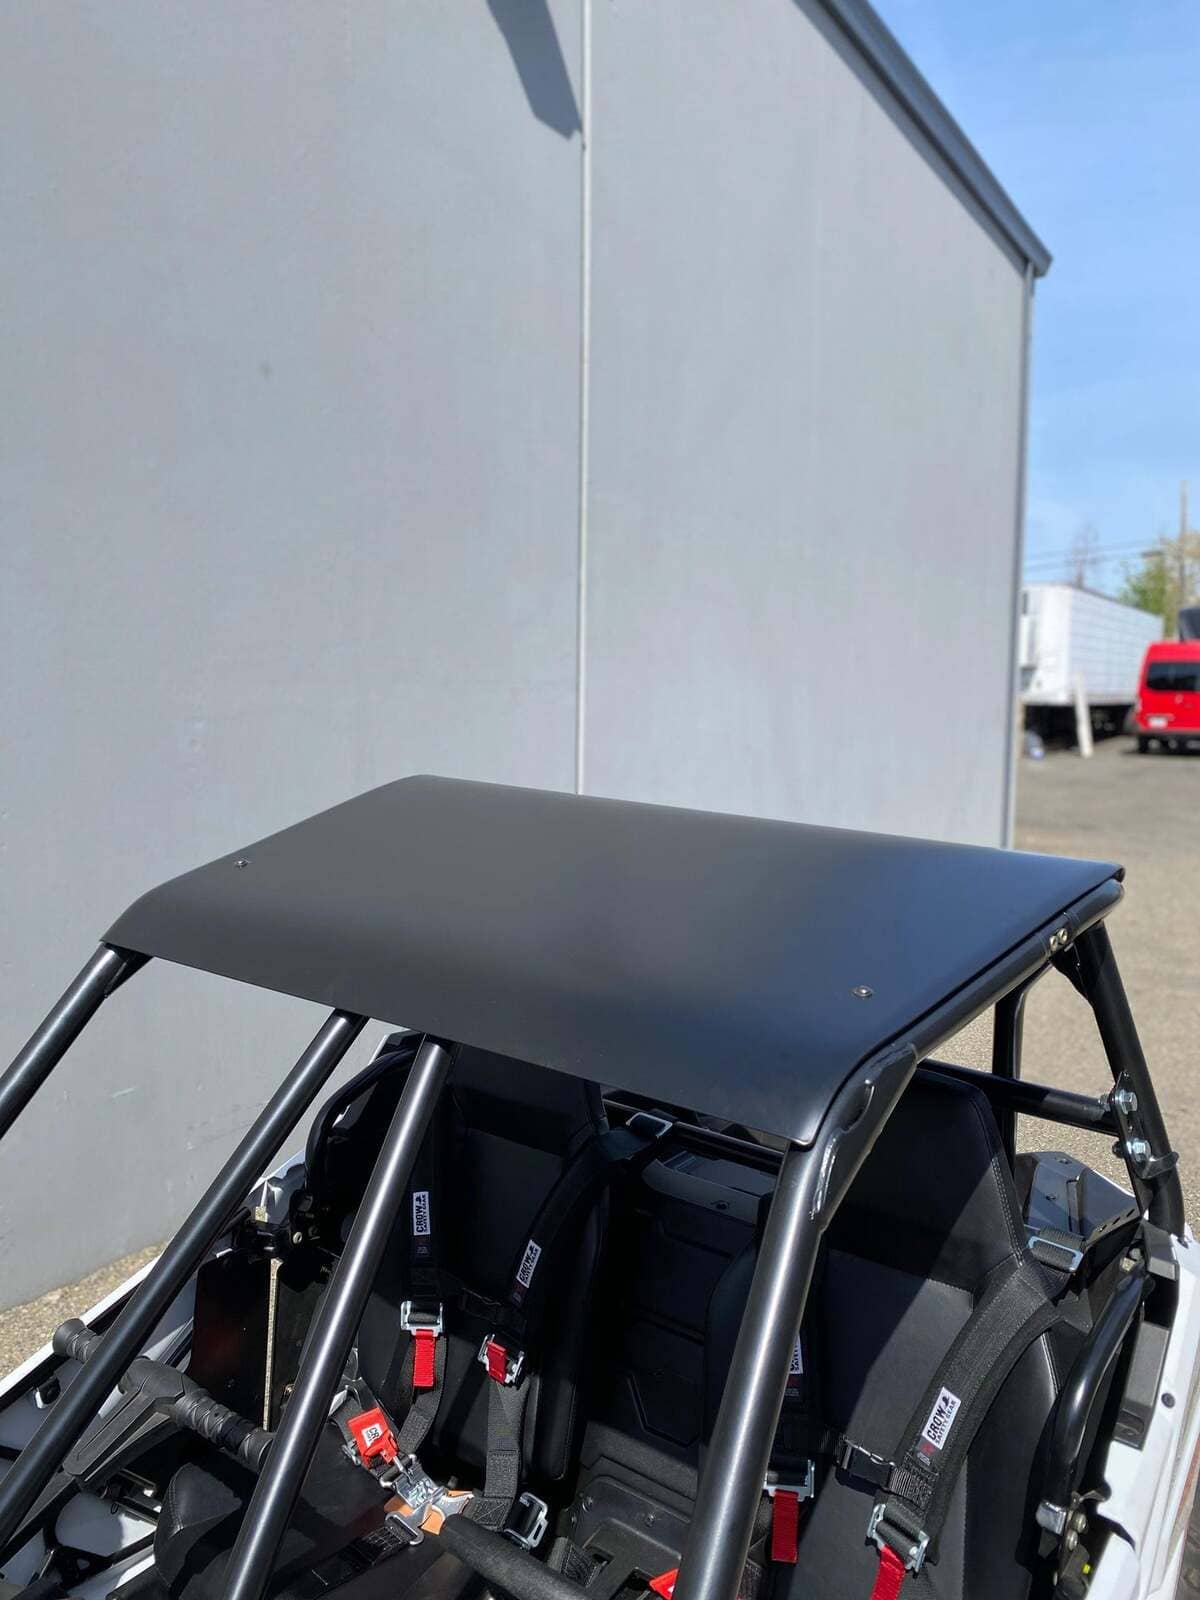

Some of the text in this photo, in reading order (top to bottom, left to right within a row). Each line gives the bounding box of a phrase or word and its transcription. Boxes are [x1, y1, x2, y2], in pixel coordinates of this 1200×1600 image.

[416, 1204, 424, 1233] CROW
[518, 1252, 531, 1281] CROW
[926, 1404, 947, 1441] CROW
[935, 1400, 957, 1446] SAFETY GEAR
